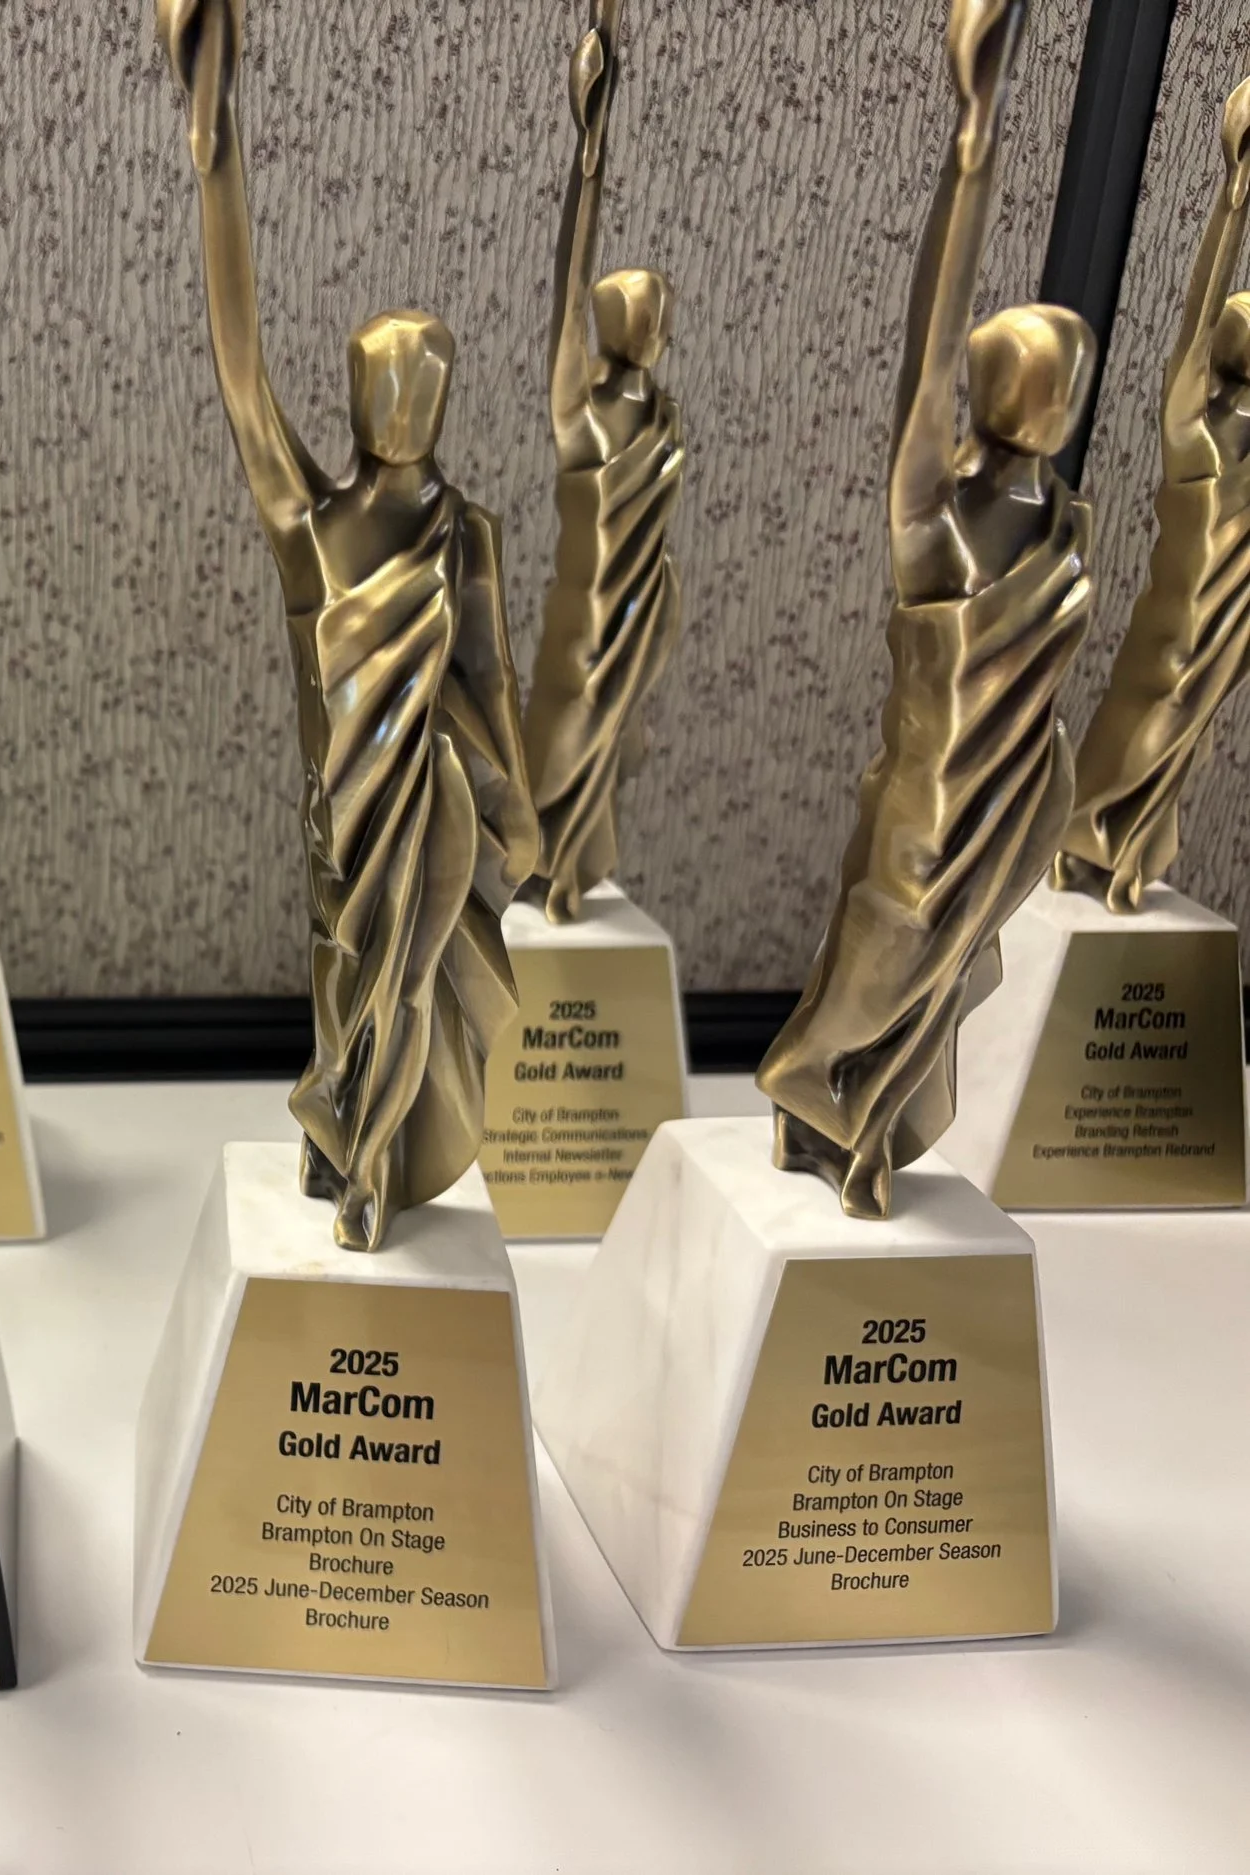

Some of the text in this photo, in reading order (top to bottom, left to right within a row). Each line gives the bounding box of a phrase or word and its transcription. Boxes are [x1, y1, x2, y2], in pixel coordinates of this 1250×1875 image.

[1121, 983, 1165, 1001] 2025
[549, 1000, 596, 1020] 2025
[1094, 1007, 1186, 1030] MarCom
[522, 1027, 620, 1050] MarCom
[1085, 1041, 1188, 1061] Gold Award
[514, 1062, 624, 1082] Gold Award
[1081, 1085, 1182, 1101] City of Brampton
[513, 1107, 619, 1124] City of Brampton
[1064, 1105, 1193, 1120] Experience Brampton
[541, 1129, 648, 1143] Communications
[1075, 1125, 1179, 1140] Branding Refresh
[503, 1148, 622, 1162] Internal Newsletter
[1032, 1143, 1215, 1160] Experience Brampton Rebrand
[485, 1168, 634, 1184] ctions Employee e-New
[862, 1319, 926, 1344] 2025
[330, 1348, 399, 1376] 2025
[824, 1353, 958, 1384] MarCom
[290, 1381, 434, 1420] MarCom
[811, 1400, 962, 1428] Gold Award
[278, 1430, 441, 1464] Gold Award
[808, 1463, 954, 1486] City of Brampton
[276, 1494, 434, 1523] City of Brampton
[793, 1489, 963, 1513] Brampton On Stage
[262, 1522, 446, 1553] Brampton On Stage
[778, 1517, 973, 1539] Business to Consumer
[309, 1552, 394, 1575] Brochure
[742, 1542, 1001, 1567] 2025 June-December Season
[210, 1575, 490, 1608] 2025 June-December Season
[831, 1572, 909, 1590] Brochure
[306, 1608, 390, 1630] Brochure
